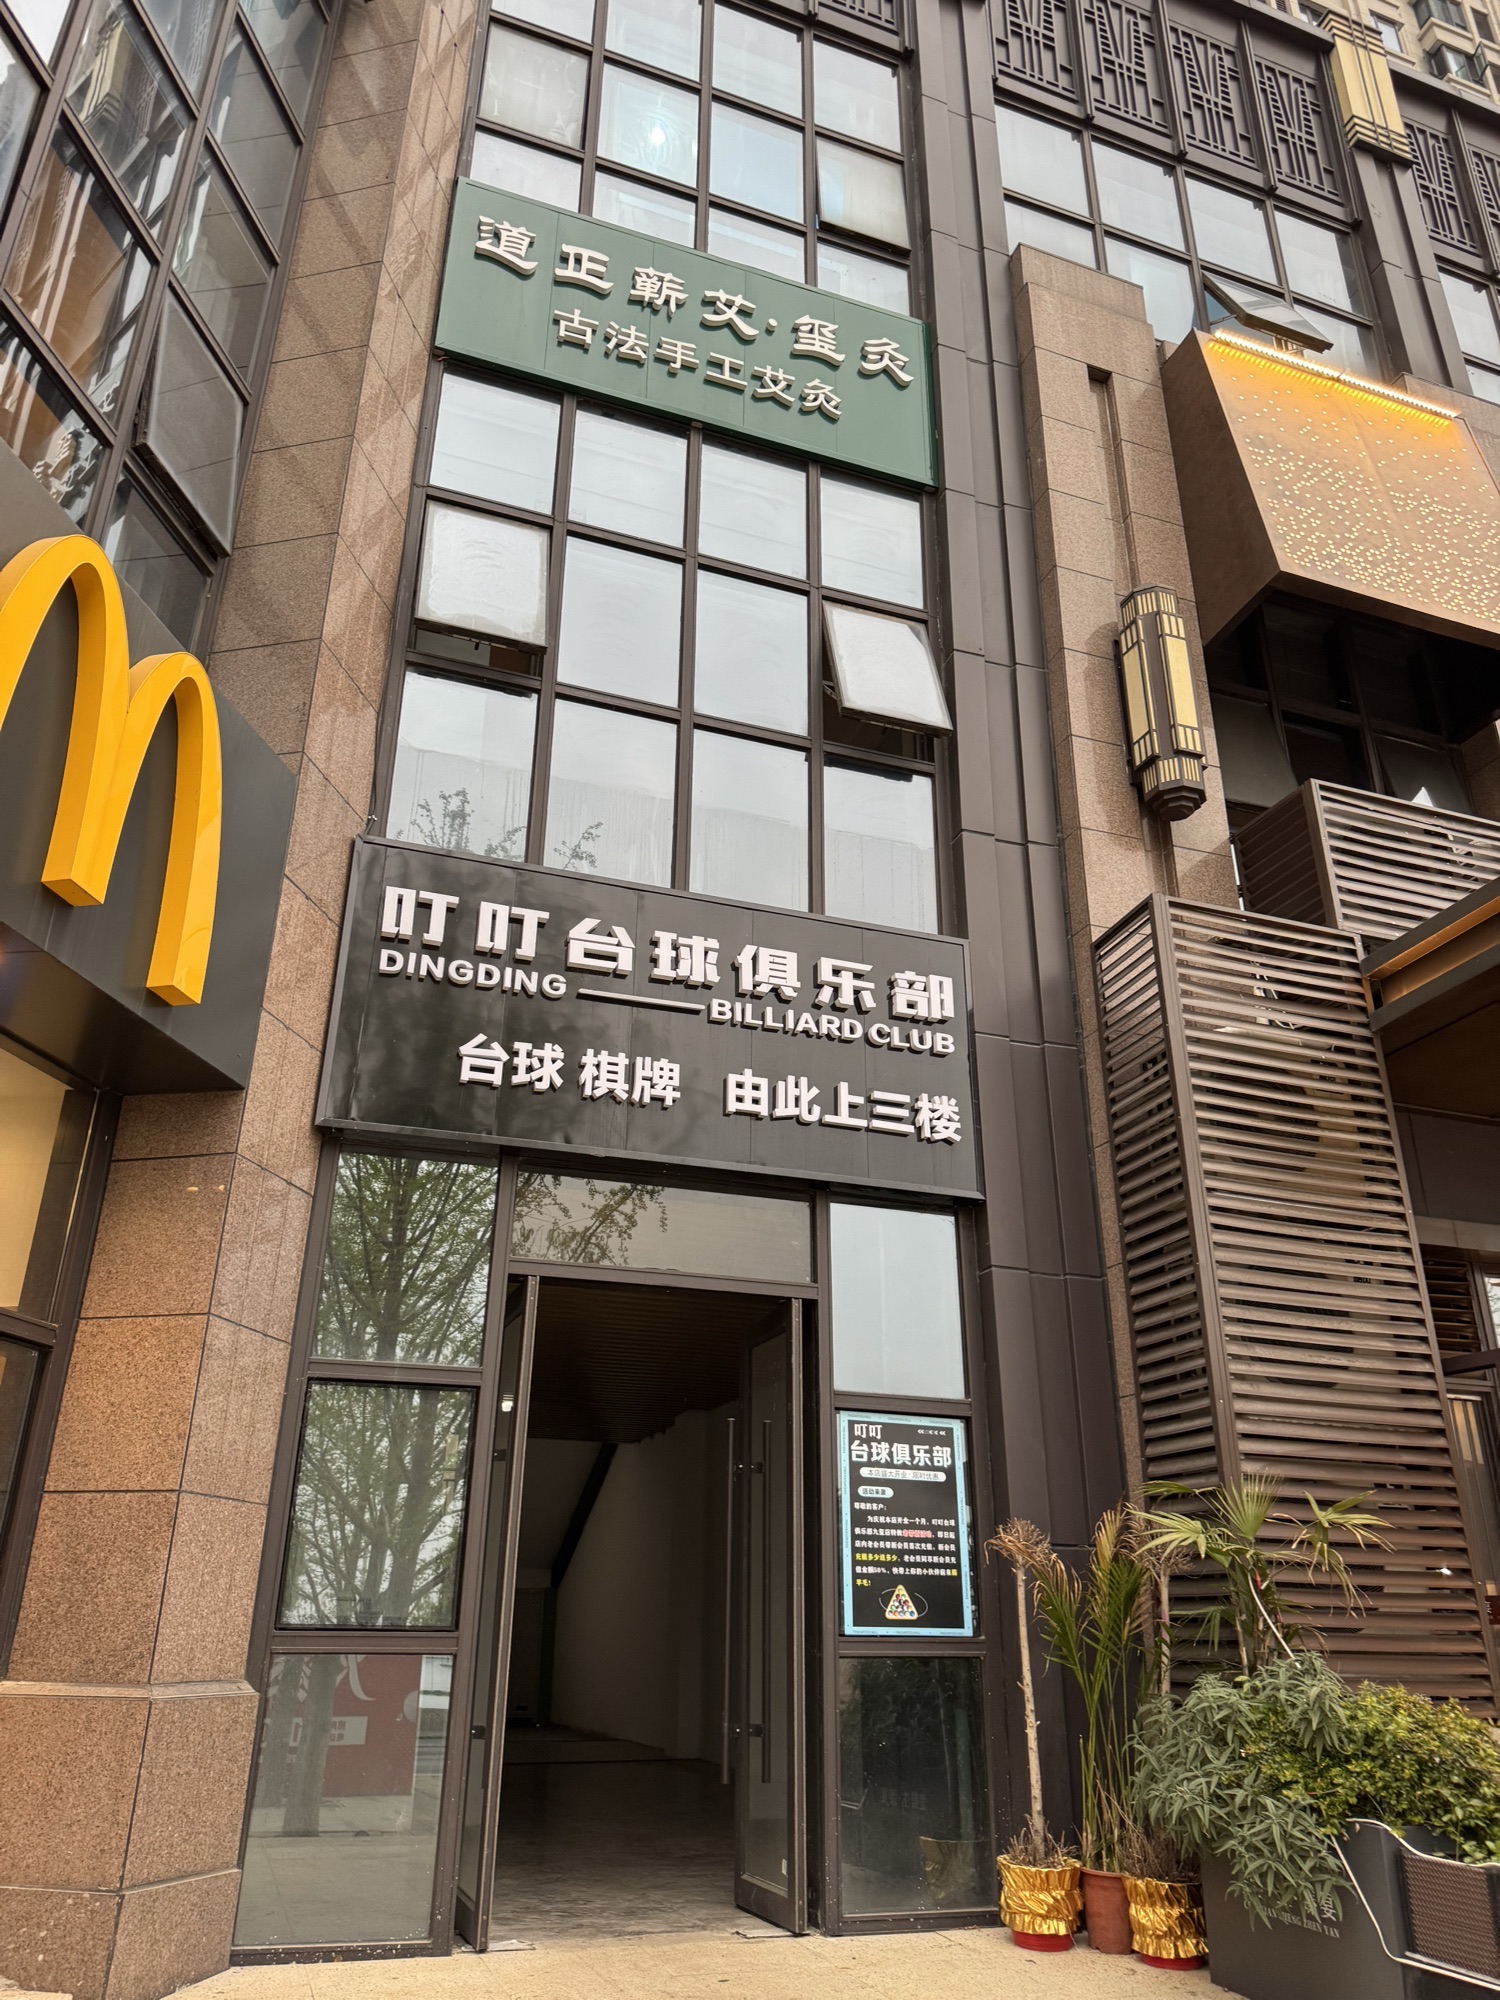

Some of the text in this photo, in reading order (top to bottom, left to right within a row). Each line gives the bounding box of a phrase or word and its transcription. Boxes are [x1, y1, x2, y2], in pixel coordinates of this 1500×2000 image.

[553, 308, 843, 420] 古法手工艾灸
[379, 948, 955, 1055] DINGDING BILLIARD CLUB
[381, 886, 955, 1022] 叮叮台球俱乐部
[458, 1033, 962, 1143] 台球 棋牌 由此上三楼
[850, 1440, 952, 1467] 台球俱乐部
[854, 1423, 882, 1439] 叮叮
[1323, 1924, 1341, 1939] YAN
